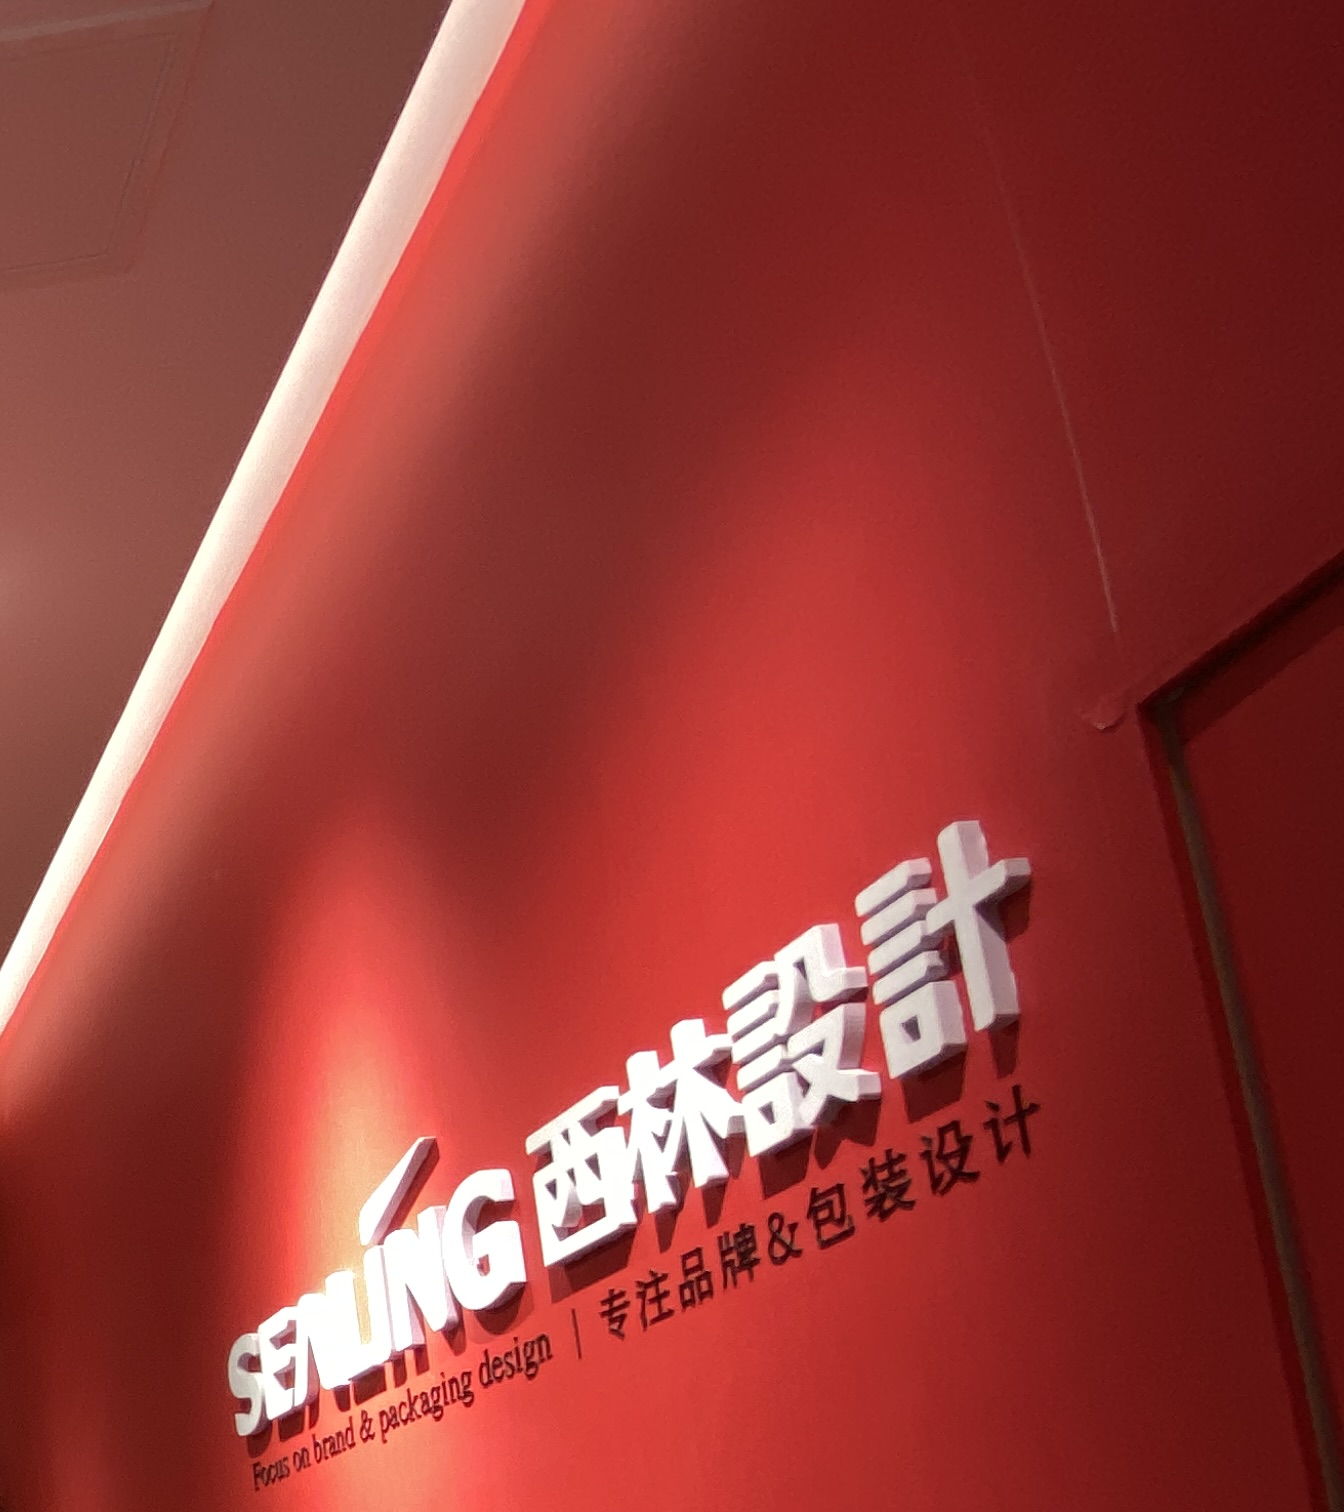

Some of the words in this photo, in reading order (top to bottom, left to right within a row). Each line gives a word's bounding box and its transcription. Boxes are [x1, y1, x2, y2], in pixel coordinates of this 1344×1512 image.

[526, 821, 1032, 1267] 西林設計
[253, 1455, 291, 1491] Focus
[293, 1446, 311, 1473] on
[313, 1422, 356, 1464] brand
[359, 1409, 376, 1442] &
[379, 1370, 474, 1443] packaging
[479, 1333, 554, 1388] design
